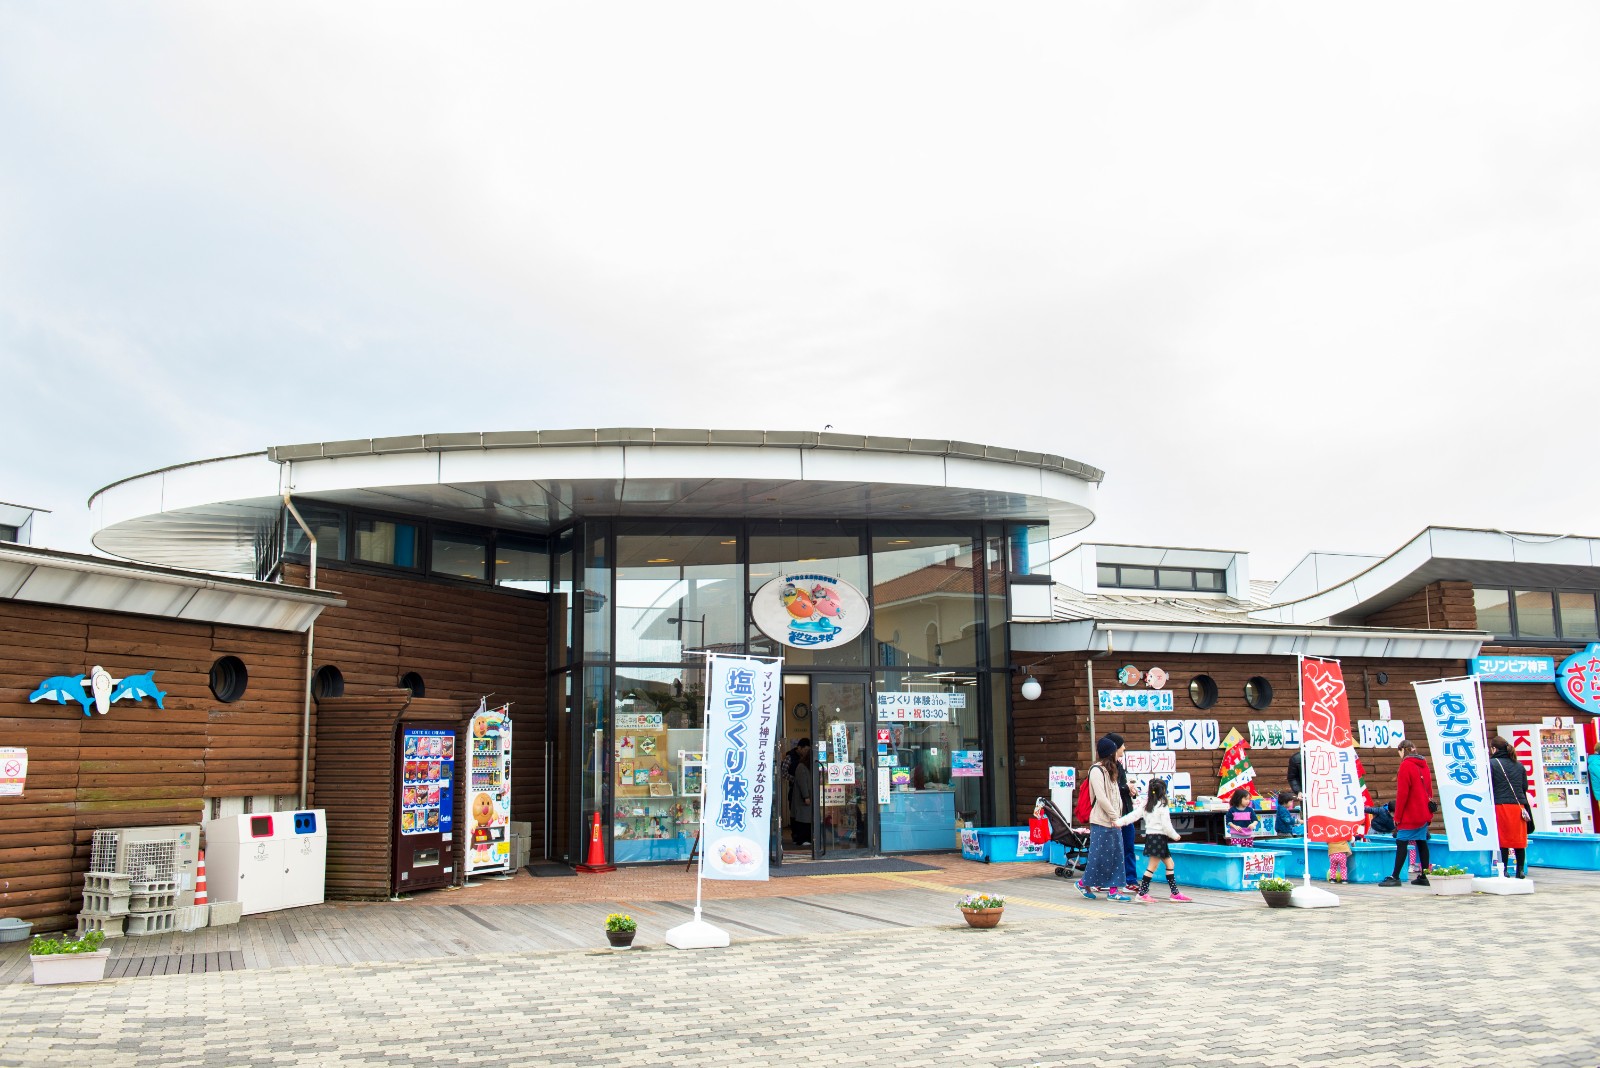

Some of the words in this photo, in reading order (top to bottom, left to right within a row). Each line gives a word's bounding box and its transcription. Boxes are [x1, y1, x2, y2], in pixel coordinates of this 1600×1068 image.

[1479, 660, 1548, 673] マリンピア神戸
[878, 695, 911, 705] 塩づくり
[913, 695, 931, 706] 体験
[1099, 690, 1172, 709] おさかなつり
[1150, 721, 1217, 747] 塩づくり
[718, 669, 755, 830] 塩づくり体験
[1119, 753, 1176, 771] 年オリジナル
[1512, 729, 1538, 809] KIR
[1338, 751, 1358, 817] ヨーヨーつり
